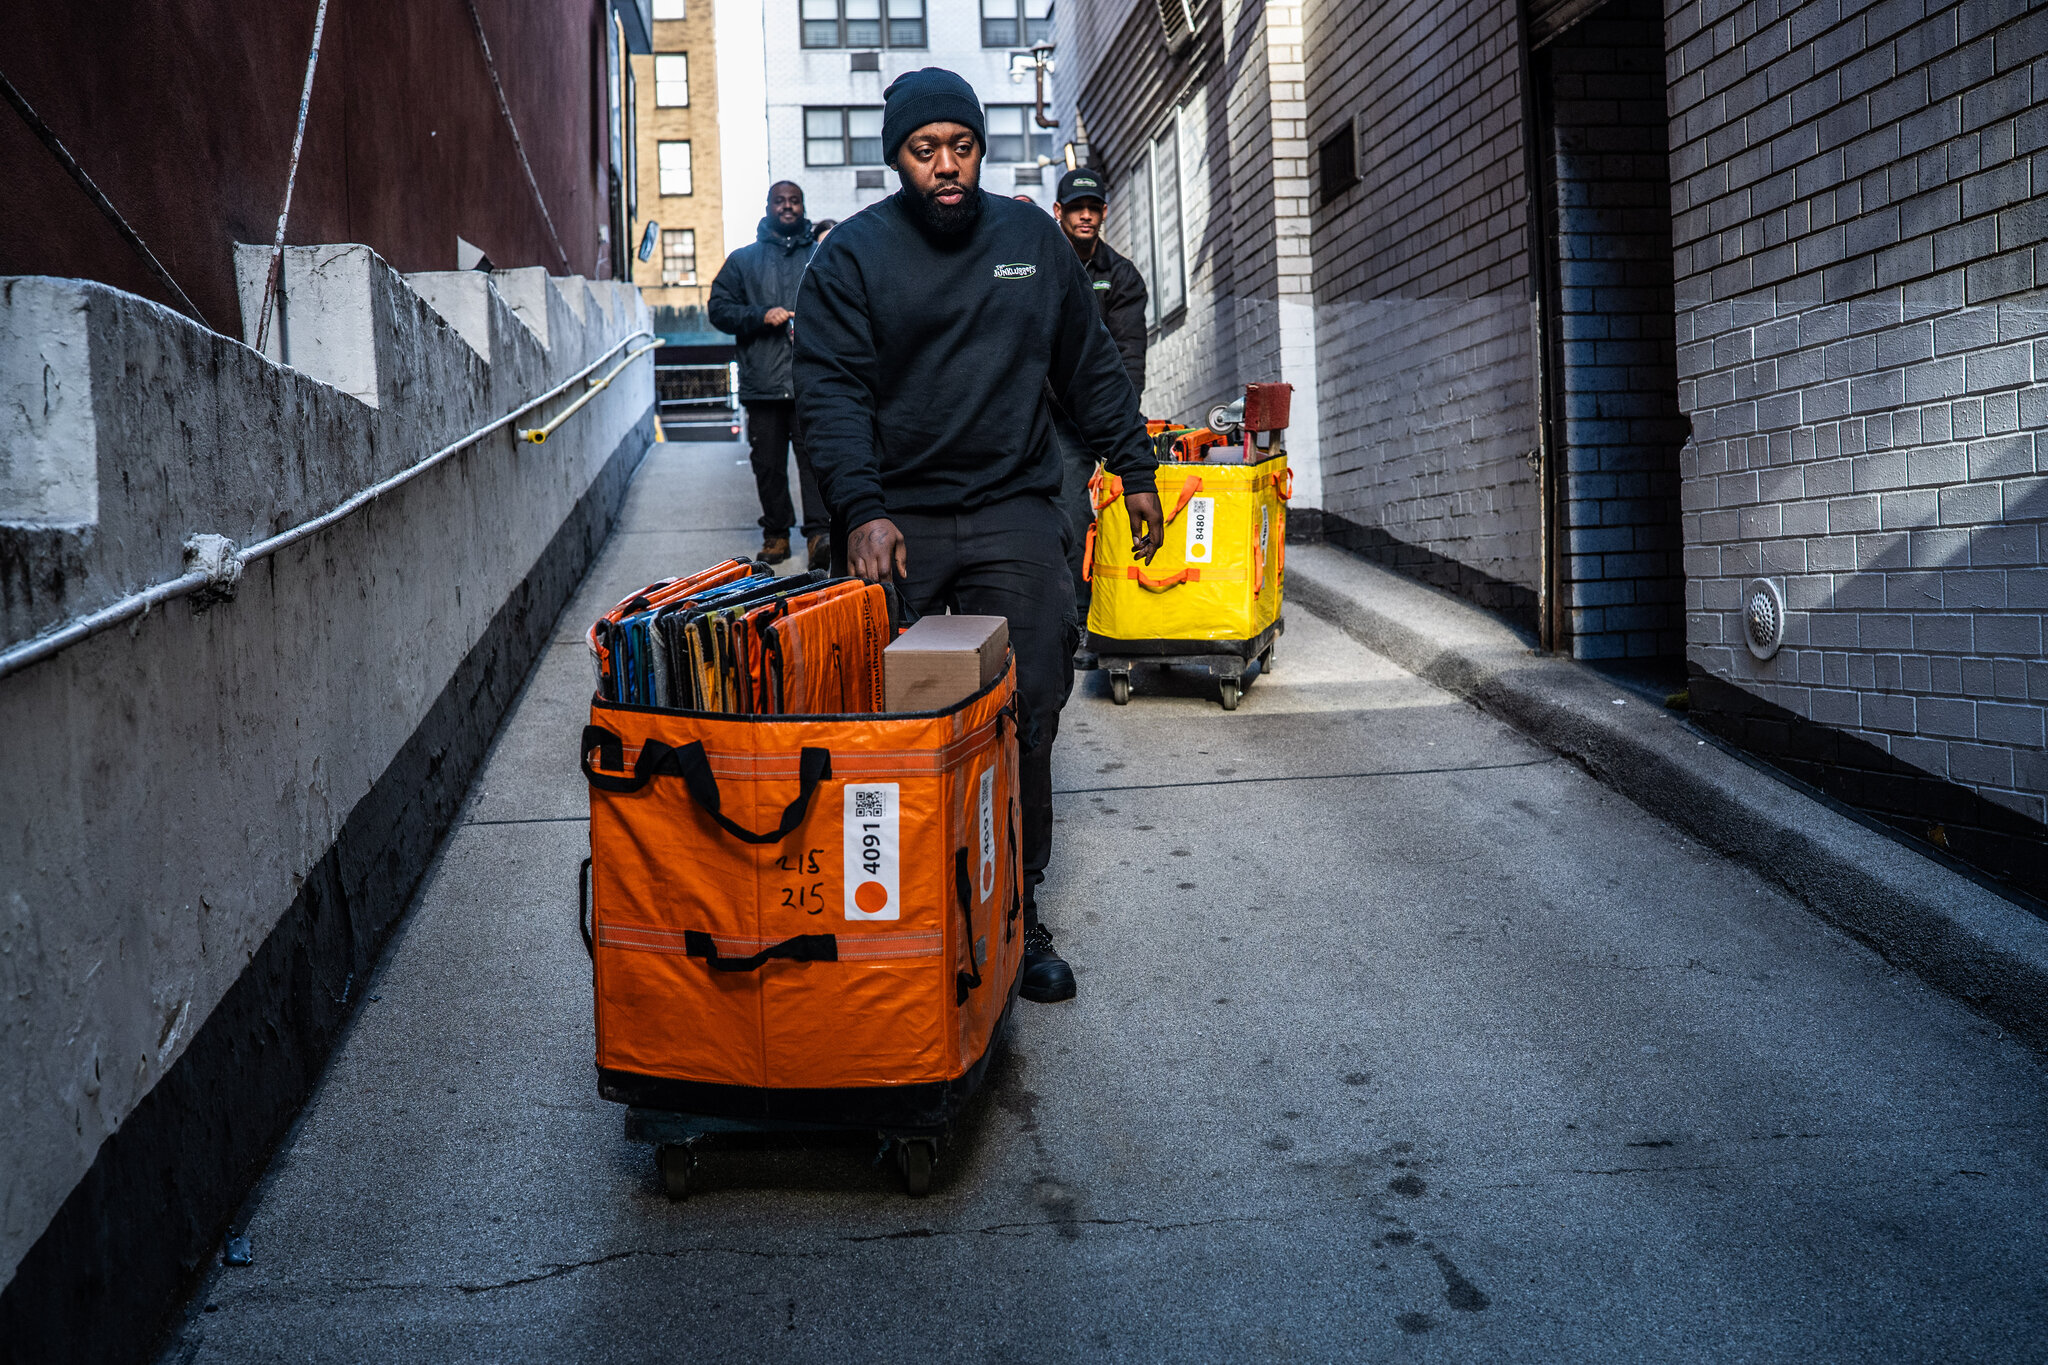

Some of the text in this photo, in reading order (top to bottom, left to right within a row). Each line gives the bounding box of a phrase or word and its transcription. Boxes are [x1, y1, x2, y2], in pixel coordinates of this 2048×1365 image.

[1195, 514, 1205, 540] 8480
[775, 848, 825, 875] 215
[863, 823, 881, 875] 4091
[781, 881, 825, 915] 215
